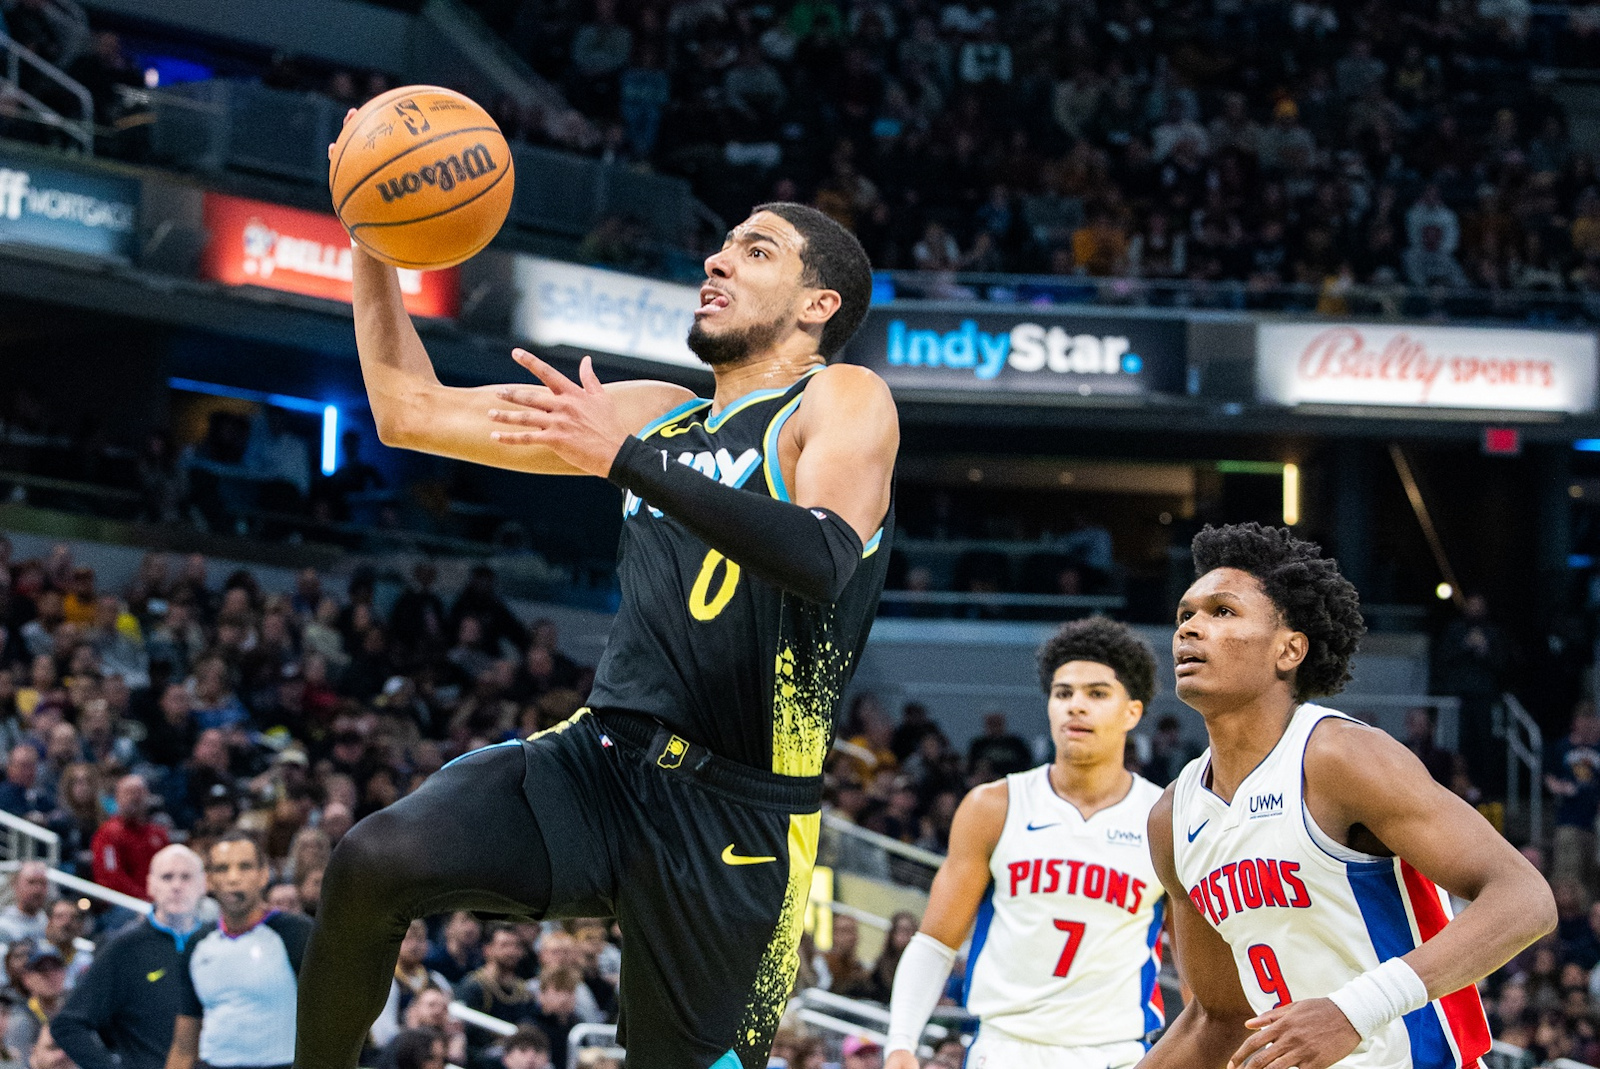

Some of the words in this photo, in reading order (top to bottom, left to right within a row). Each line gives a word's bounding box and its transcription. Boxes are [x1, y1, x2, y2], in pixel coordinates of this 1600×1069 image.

[375, 142, 497, 203] Wilson
[887, 319, 1143, 380] IndyStar.
[1299, 325, 1445, 404] Bally
[1451, 356, 1554, 388] SPORTS
[689, 548, 740, 621] 0
[1249, 792, 1283, 813] UWM
[1106, 828, 1142, 843] UWM
[1008, 858, 1147, 915] PISTONS
[1188, 858, 1312, 926] PISTONS
[1053, 919, 1086, 978] 7
[1248, 943, 1293, 1010] 9
